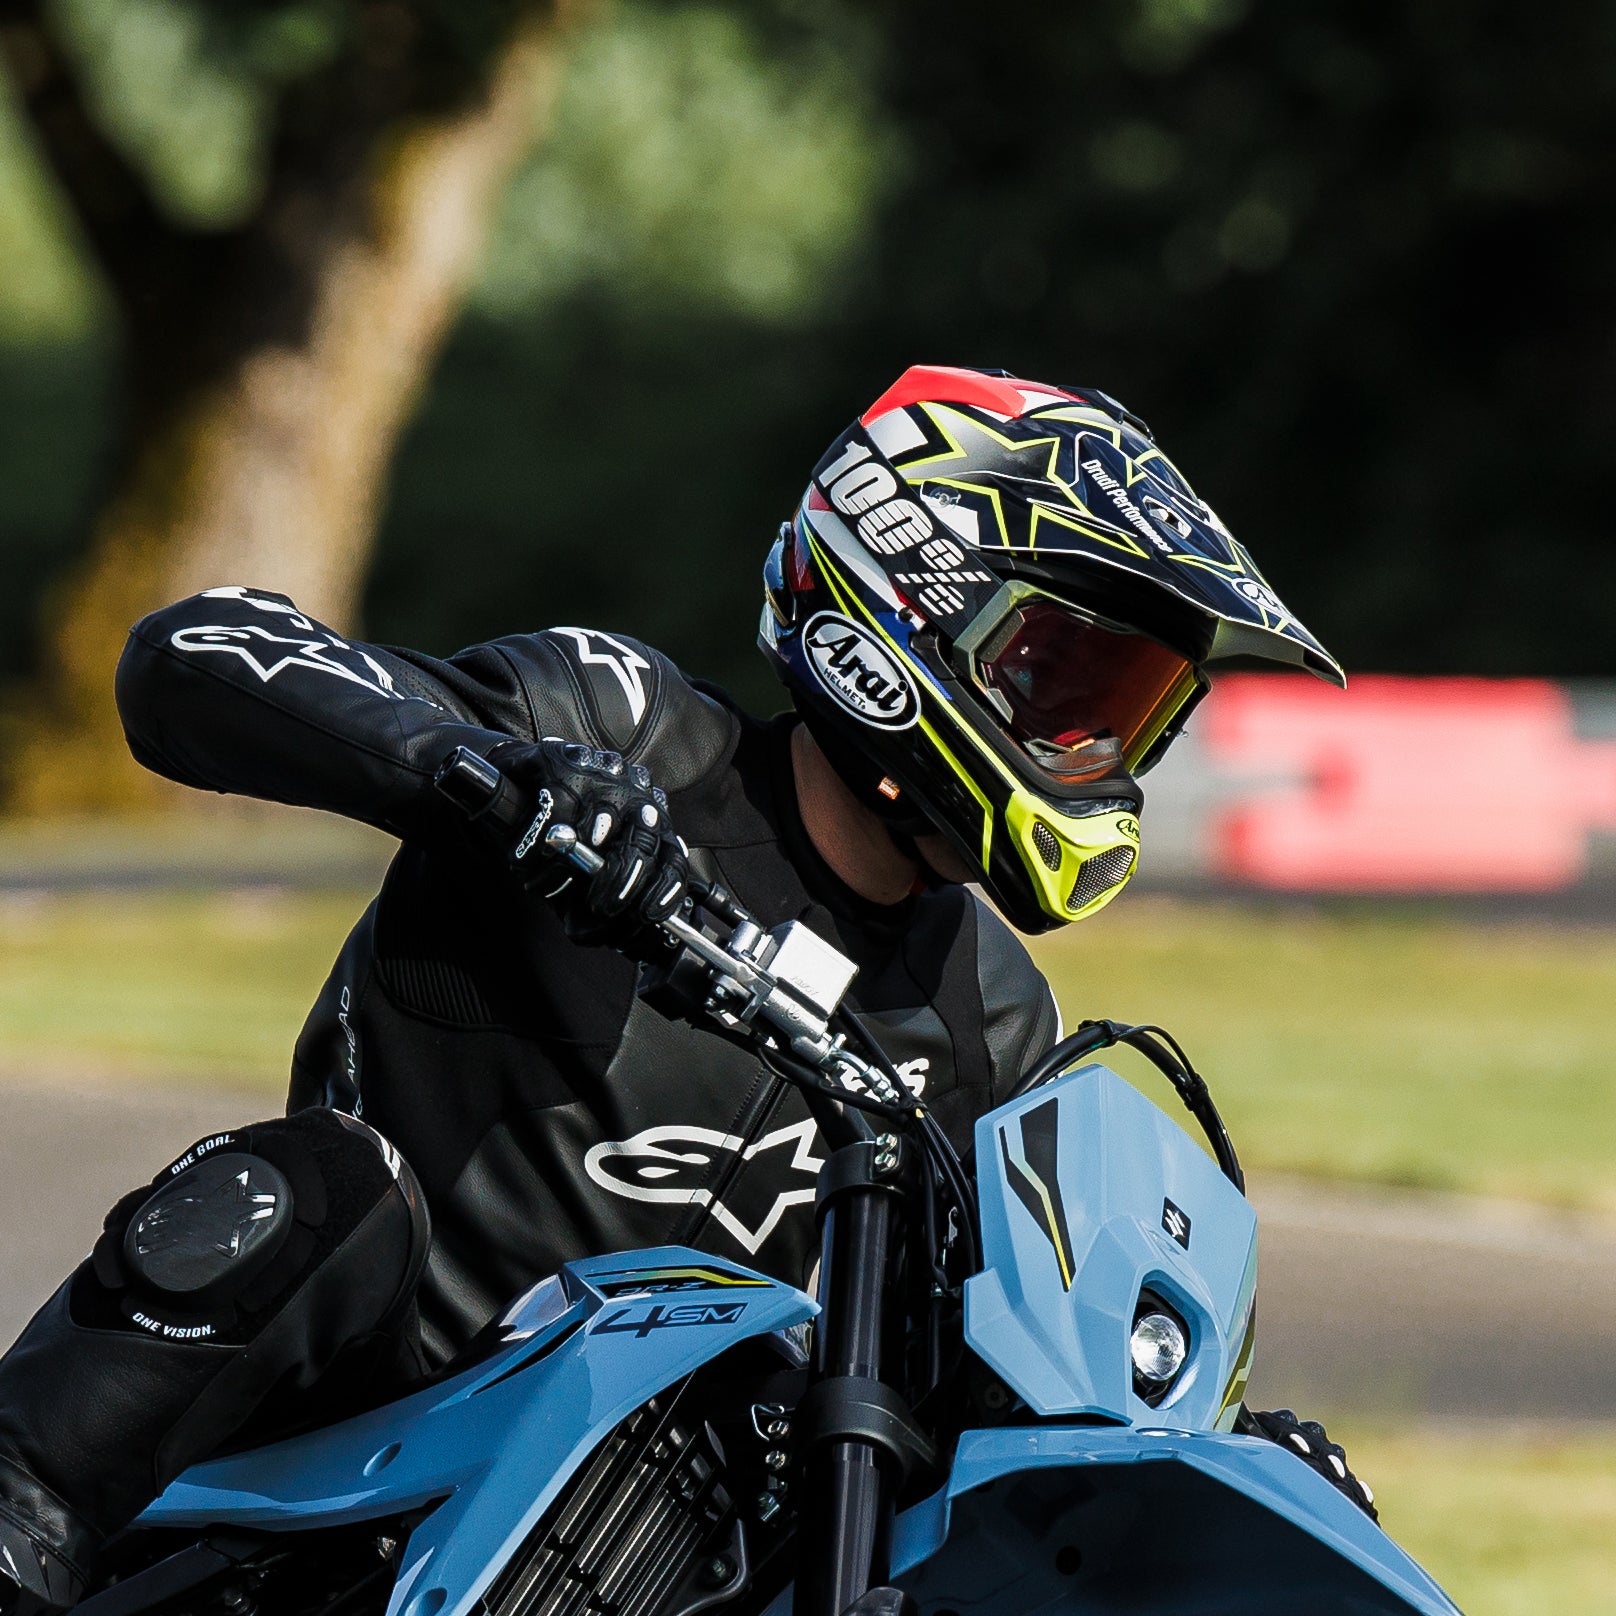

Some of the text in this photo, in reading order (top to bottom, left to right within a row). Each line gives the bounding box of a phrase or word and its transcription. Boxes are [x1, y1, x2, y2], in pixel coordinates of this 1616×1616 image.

[818, 440, 992, 616] 100%
[1081, 459, 1173, 553] Drudi Performance
[807, 633, 908, 712] Arai
[338, 985, 357, 1087] AHEAD
[171, 1152, 195, 1175] ONE
[132, 1312, 216, 1338] ONE VISION.
